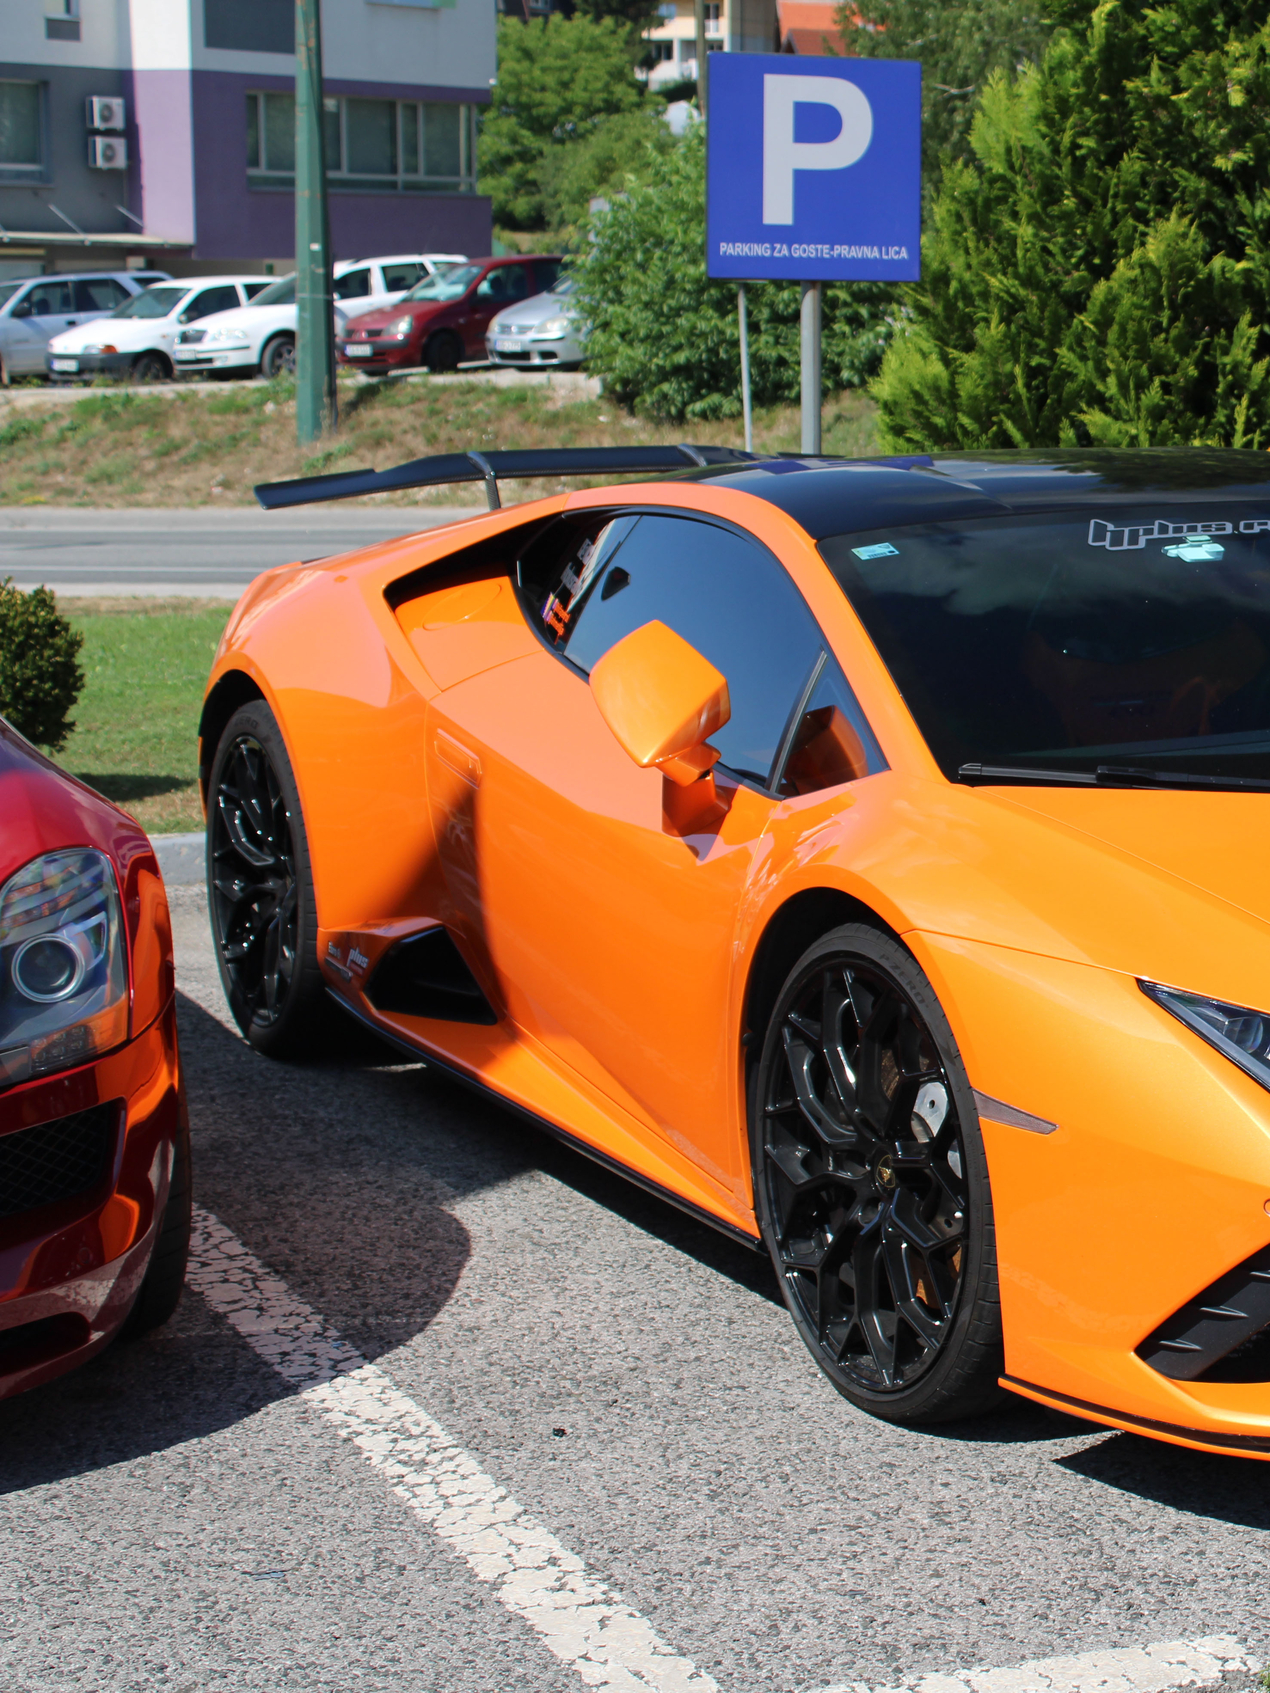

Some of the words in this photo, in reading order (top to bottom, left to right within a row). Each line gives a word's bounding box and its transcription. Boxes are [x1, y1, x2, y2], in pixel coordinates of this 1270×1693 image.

[763, 73, 874, 226] P
[719, 241, 771, 257] PARKING
[773, 243, 789, 257] ZA
[791, 243, 880, 259] GOSTE-PRAVNA
[881, 246, 908, 259] LICA
